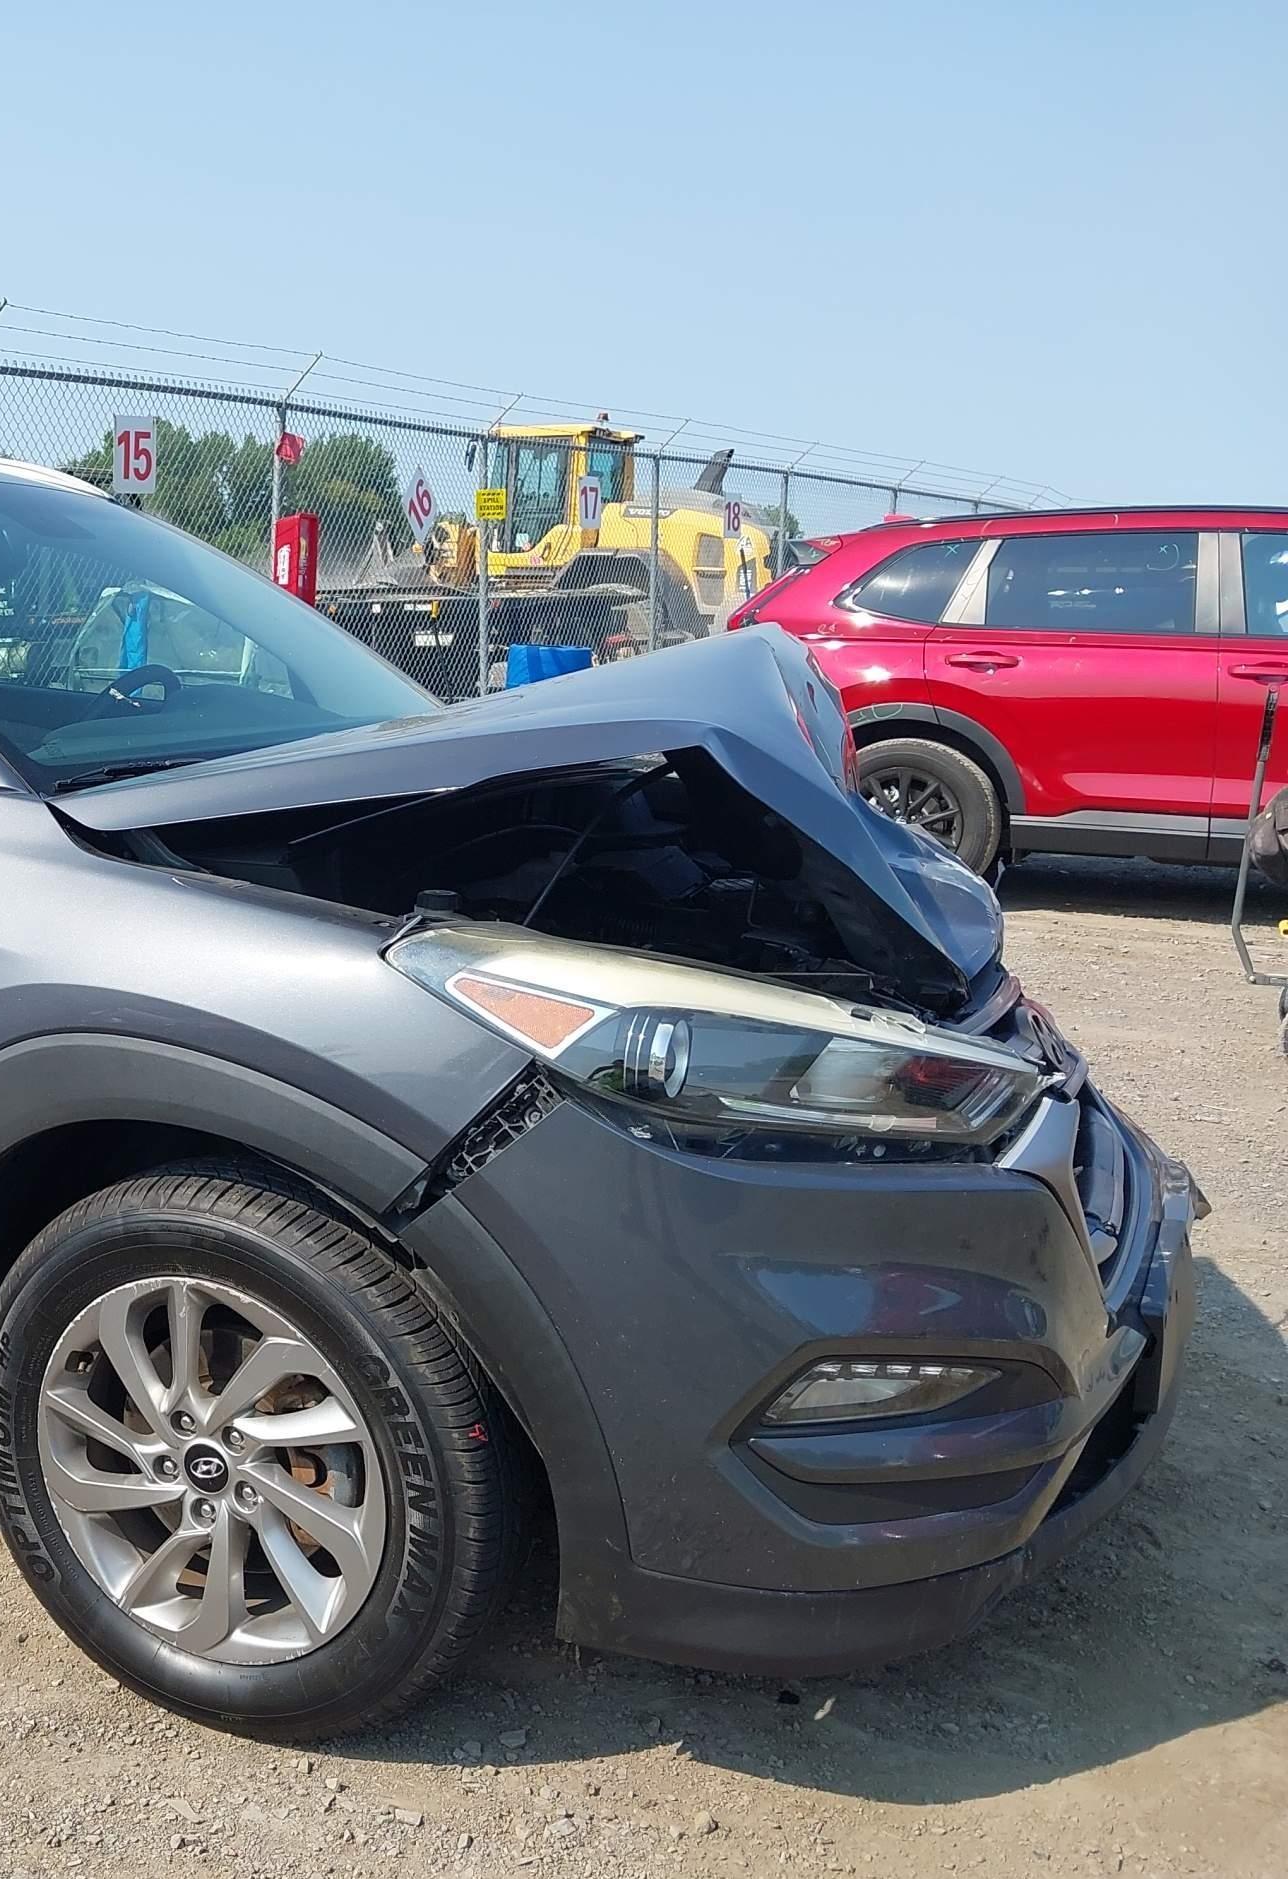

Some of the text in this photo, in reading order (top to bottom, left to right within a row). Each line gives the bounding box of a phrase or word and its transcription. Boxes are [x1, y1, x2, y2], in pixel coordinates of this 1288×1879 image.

[117, 430, 152, 481] 15
[408, 479, 432, 530] 16
[580, 486, 599, 520] 17
[628, 507, 671, 517] VOLO
[725, 501, 741, 532] 18
[357, 1352, 439, 1618] GREEN MAX
